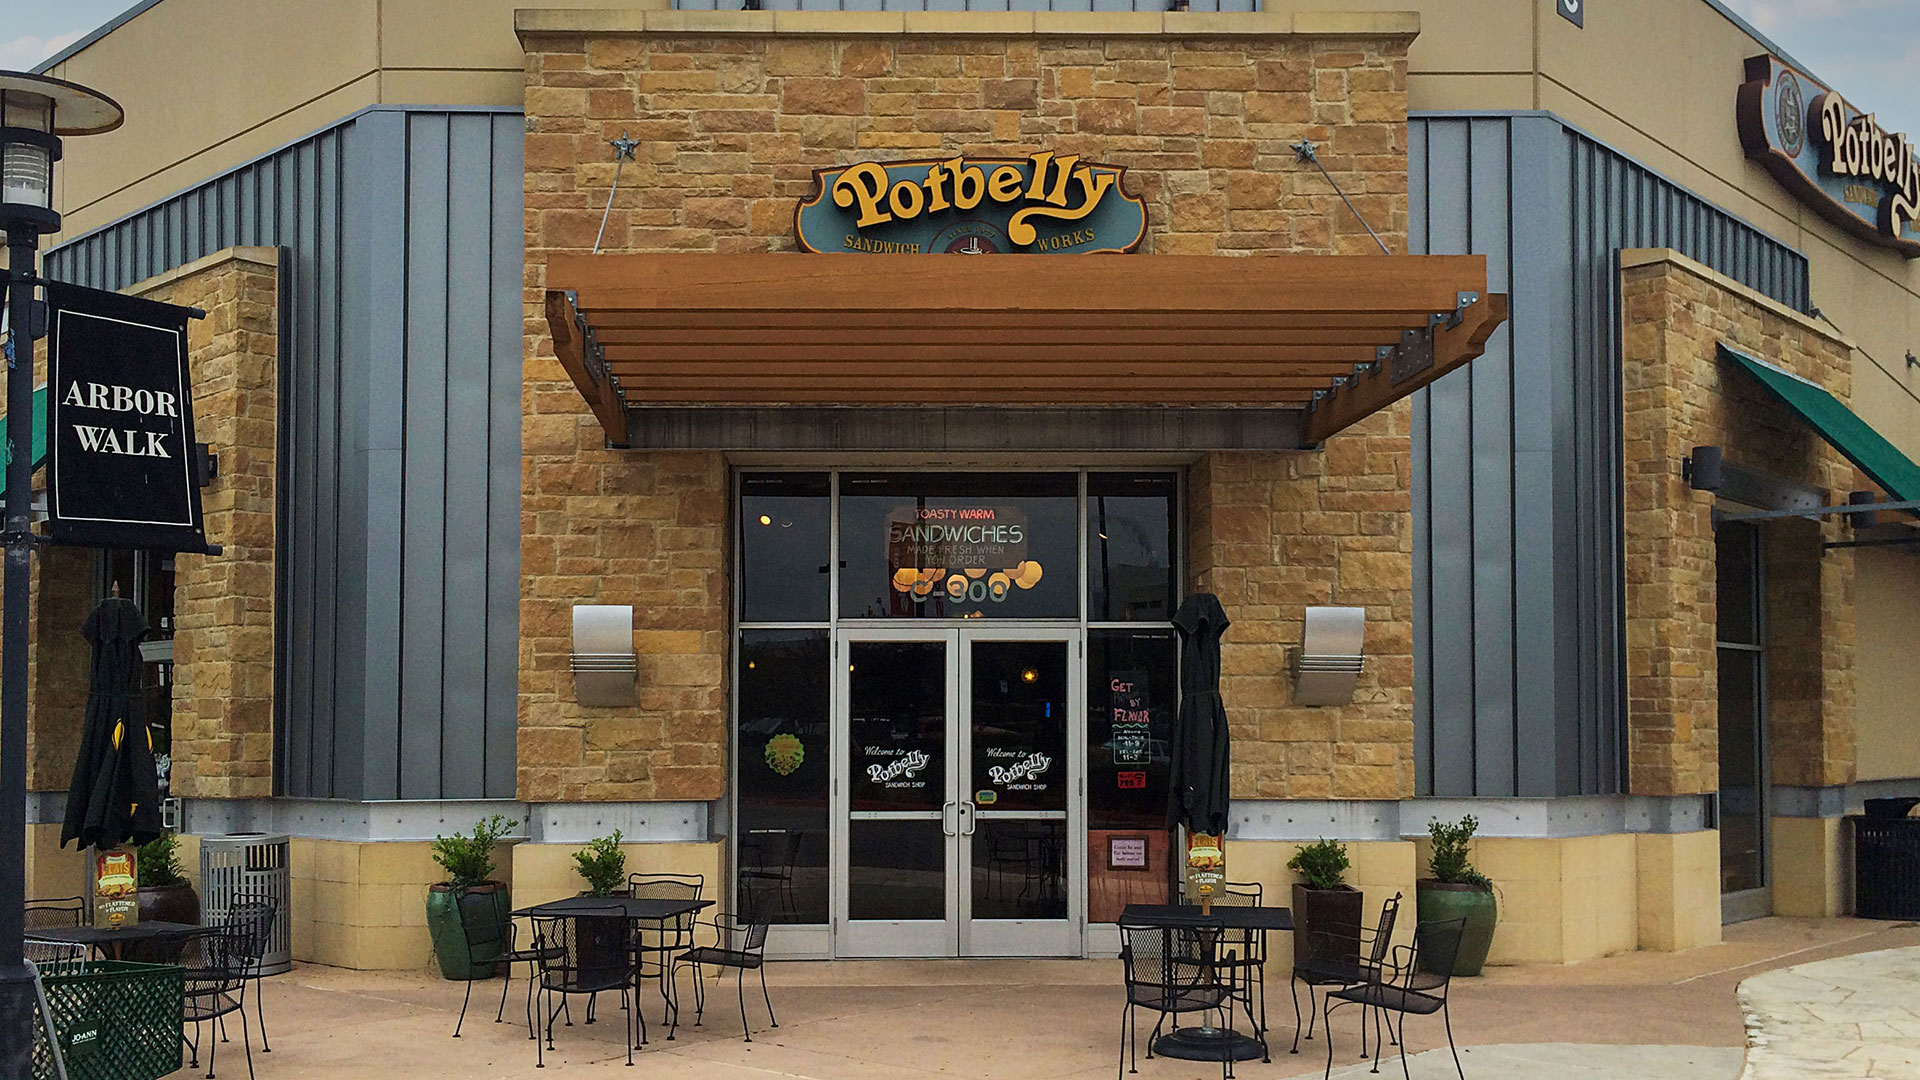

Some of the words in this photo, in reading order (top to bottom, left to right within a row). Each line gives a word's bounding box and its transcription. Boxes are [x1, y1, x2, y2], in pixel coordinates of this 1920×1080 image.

[1822, 91, 1920, 239] Potbelly
[832, 151, 1114, 246] Potbelly
[843, 234, 920, 254] SANDWICH
[1037, 228, 1095, 252] WORKS
[62, 380, 178, 418] ARBOR
[72, 424, 172, 459] WALK
[916, 509, 957, 520] TOASTY
[959, 509, 995, 520] WARM
[889, 525, 1024, 543] SANDWICHES
[907, 546, 934, 555] MADE
[977, 546, 1005, 554] WHEN
[950, 555, 986, 565] ORDER
[1111, 678, 1134, 693] GET
[1113, 708, 1150, 723] FLAVOR
[864, 746, 895, 756] Welcome
[895, 748, 905, 756] to
[986, 748, 1016, 758] Welcome
[1017, 750, 1027, 758] to
[866, 749, 930, 783] Potbelly
[988, 752, 1052, 784] Potbelly
[885, 781, 911, 789] SANDWICH
